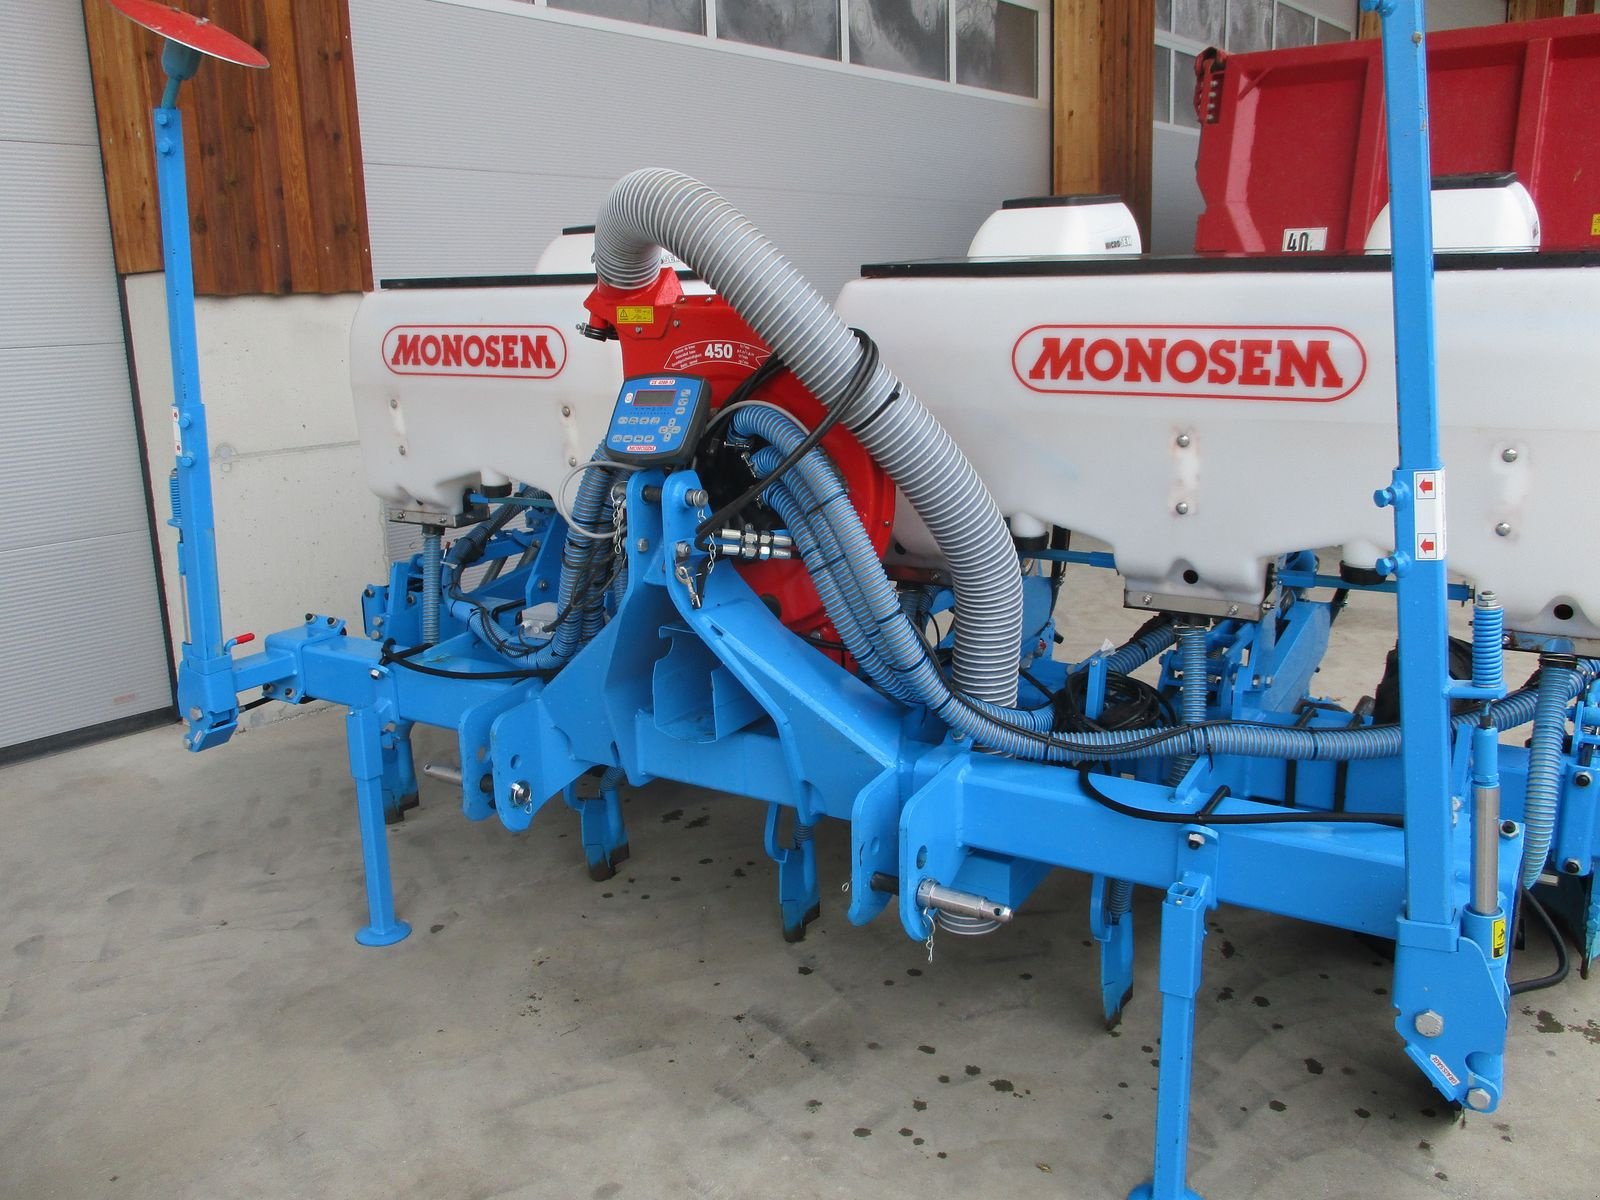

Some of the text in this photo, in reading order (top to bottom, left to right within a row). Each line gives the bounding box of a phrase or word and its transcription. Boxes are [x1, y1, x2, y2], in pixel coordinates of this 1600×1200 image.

[391, 334, 556, 369] MONOSEM
[704, 343, 733, 359] 450
[1029, 337, 1344, 388] MONOSEM
